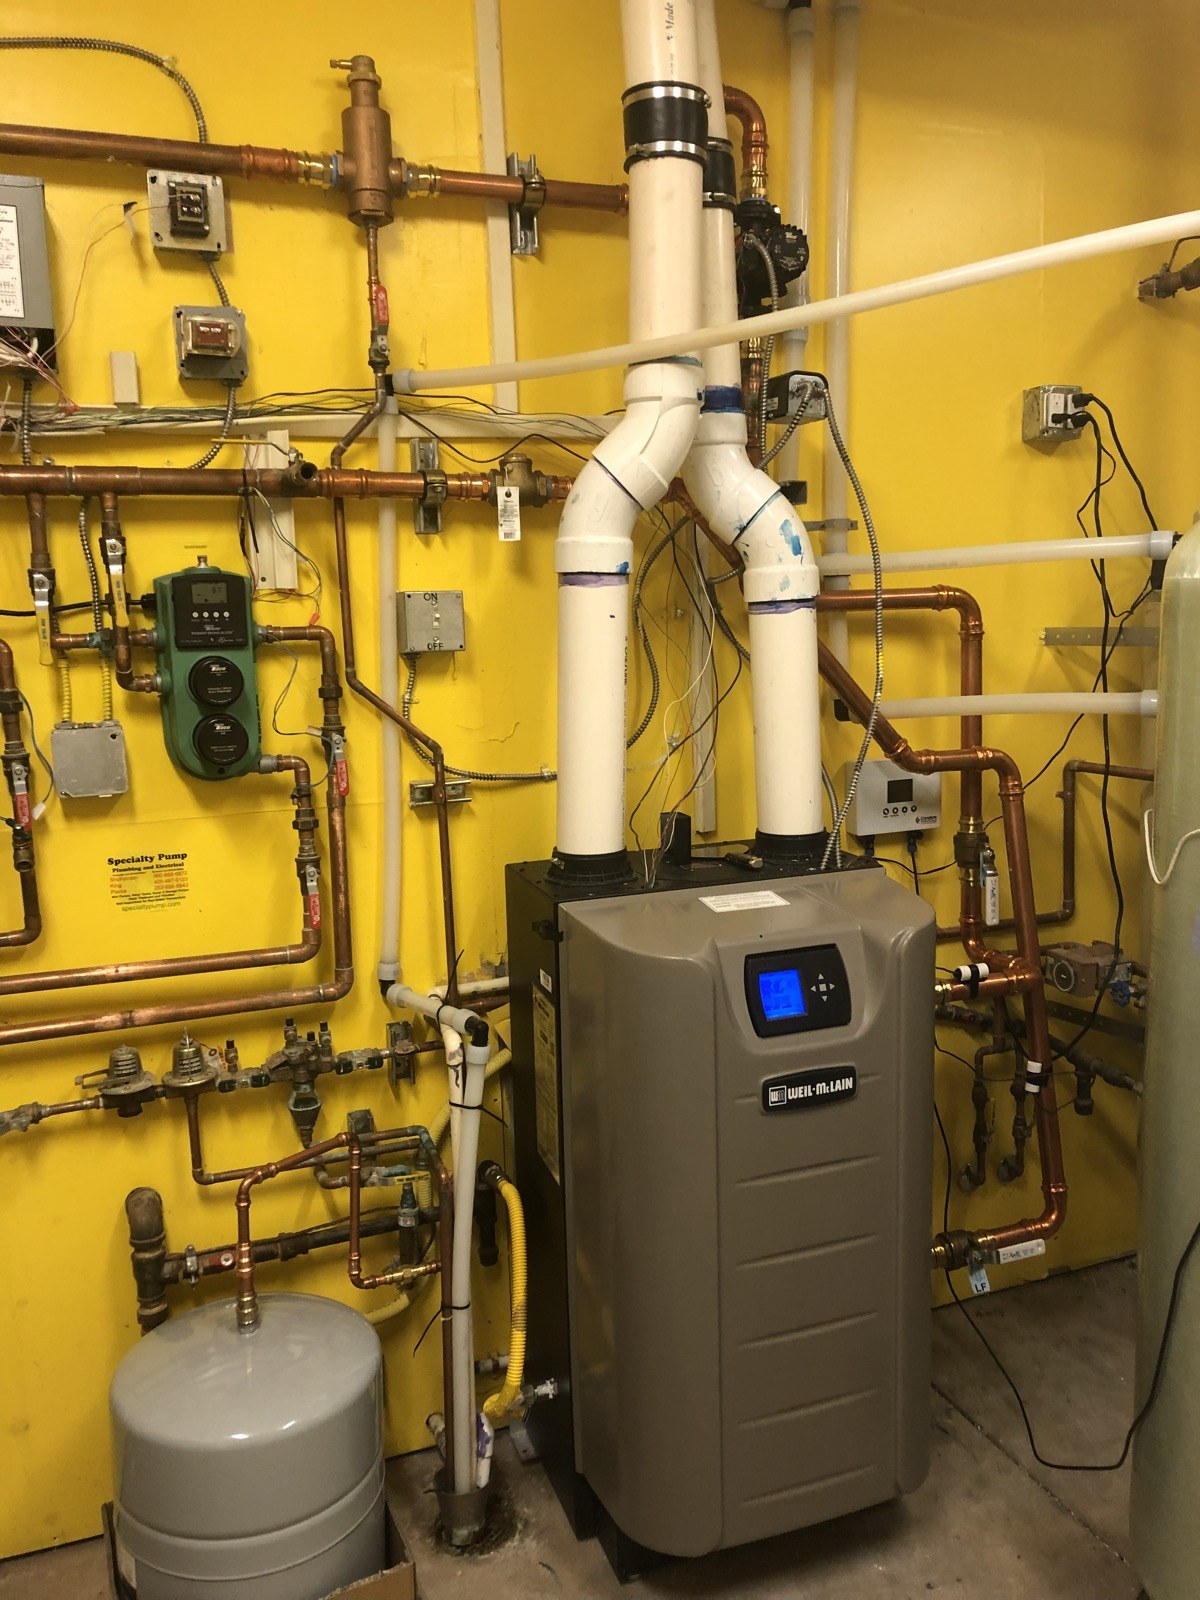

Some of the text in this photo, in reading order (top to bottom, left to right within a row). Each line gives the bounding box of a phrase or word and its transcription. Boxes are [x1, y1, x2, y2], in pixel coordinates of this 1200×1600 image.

[664, 2, 675, 31] Made
[423, 592, 438, 601] ON
[427, 642, 444, 651] OFF
[107, 852, 187, 866] Specialty Pump
[112, 865, 142, 873] Plumbing
[155, 861, 184, 869] Electrical
[974, 1282, 987, 1293] LF
